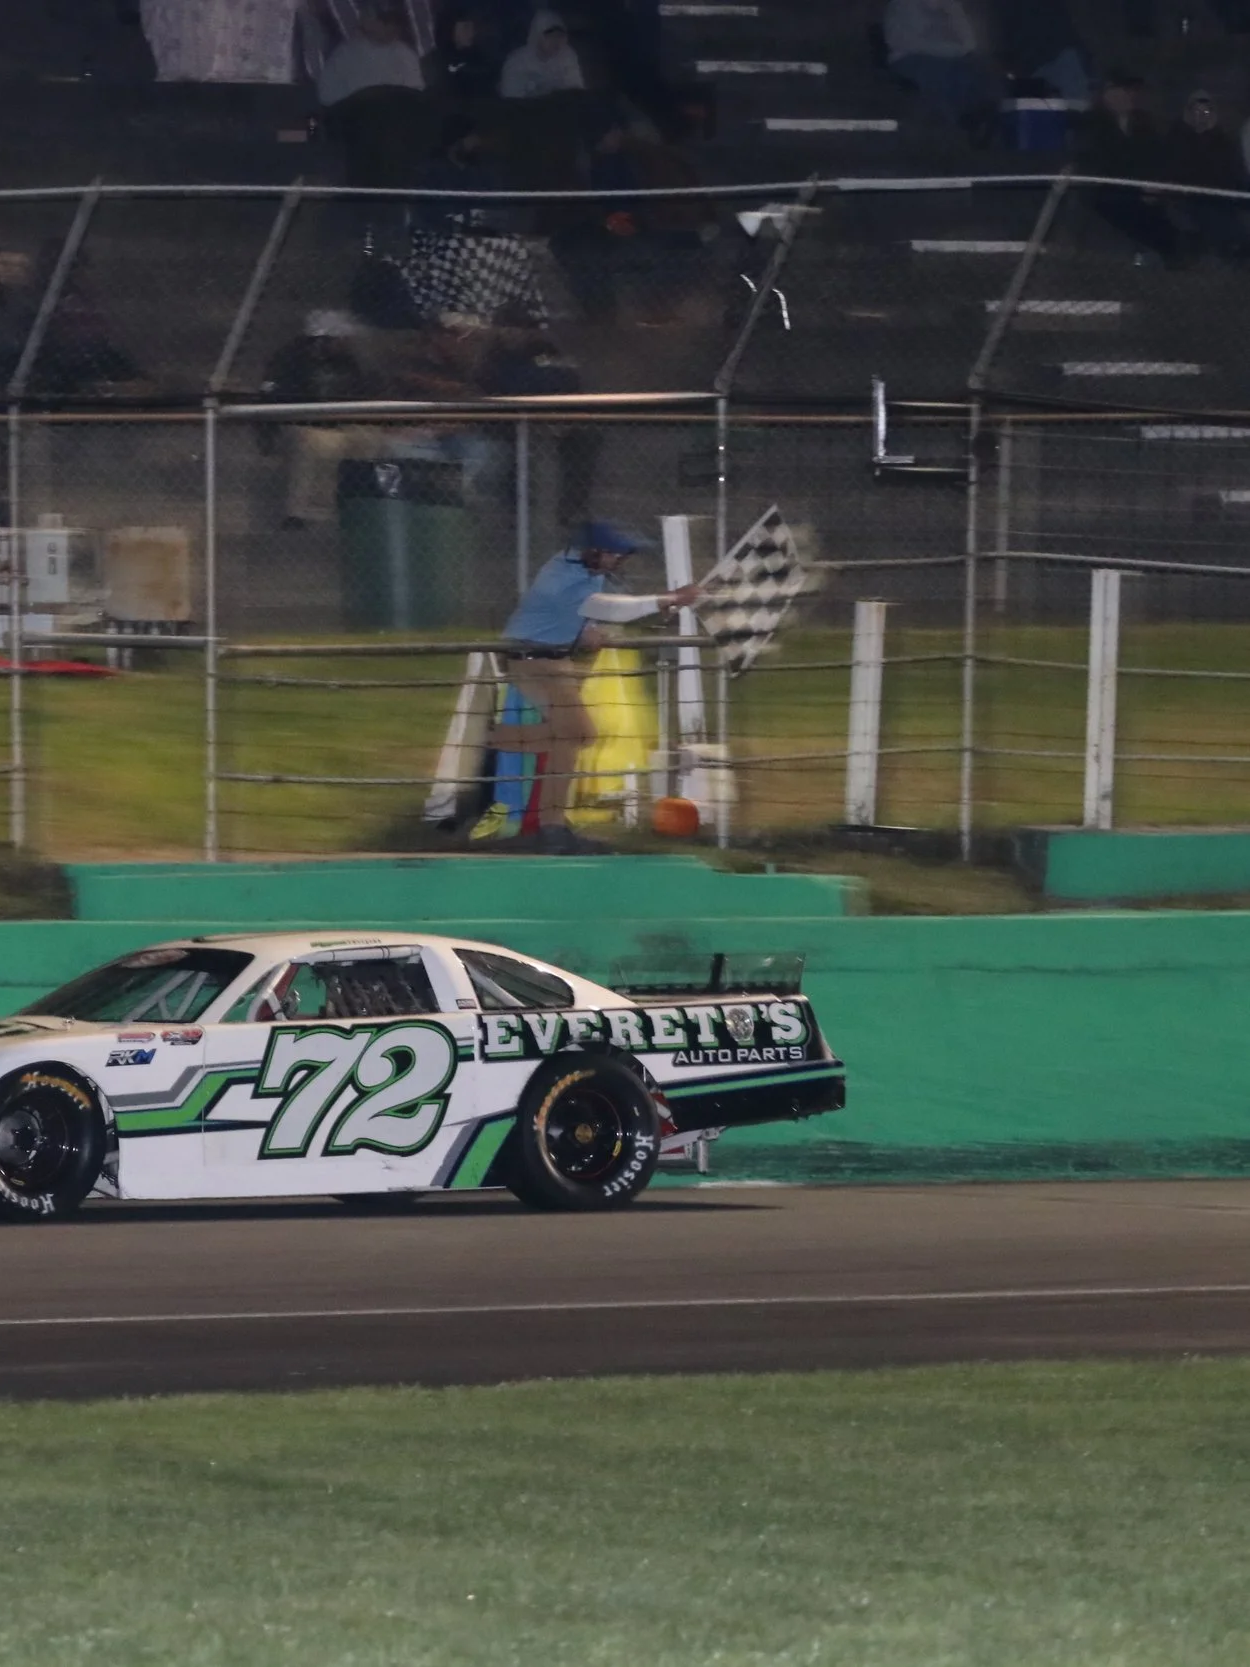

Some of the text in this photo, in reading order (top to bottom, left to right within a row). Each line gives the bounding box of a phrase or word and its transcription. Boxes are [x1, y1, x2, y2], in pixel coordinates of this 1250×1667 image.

[107, 1049, 156, 1066] RKM
[676, 1046, 803, 1064] AUTO PARTS
[252, 1019, 459, 1160] 72
[603, 1131, 654, 1196] Hoosier
